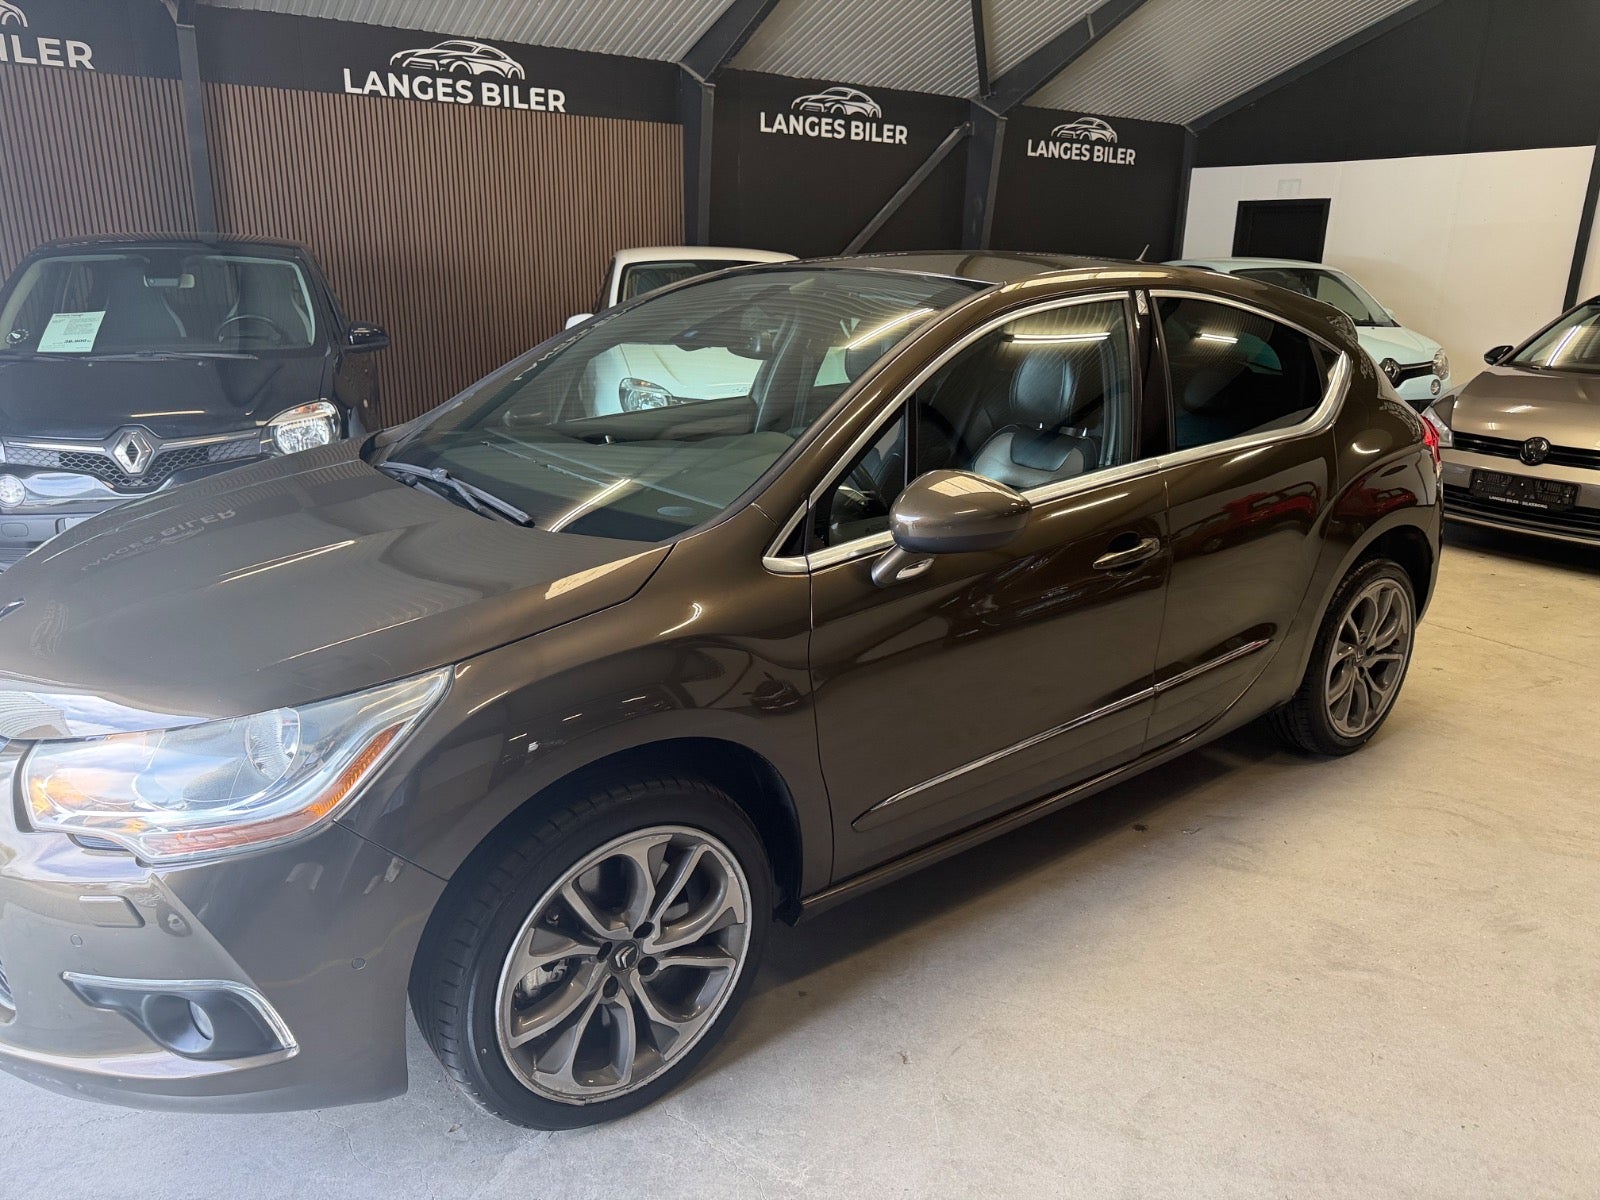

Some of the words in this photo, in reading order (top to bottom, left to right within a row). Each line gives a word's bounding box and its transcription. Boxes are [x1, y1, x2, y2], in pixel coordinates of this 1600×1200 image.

[343, 68, 474, 104] LANGES
[481, 81, 566, 113] BILER
[760, 111, 846, 140] LANGES
[850, 120, 908, 145] BILER
[1027, 138, 1091, 161] LANGES
[1093, 145, 1136, 166] BILER
